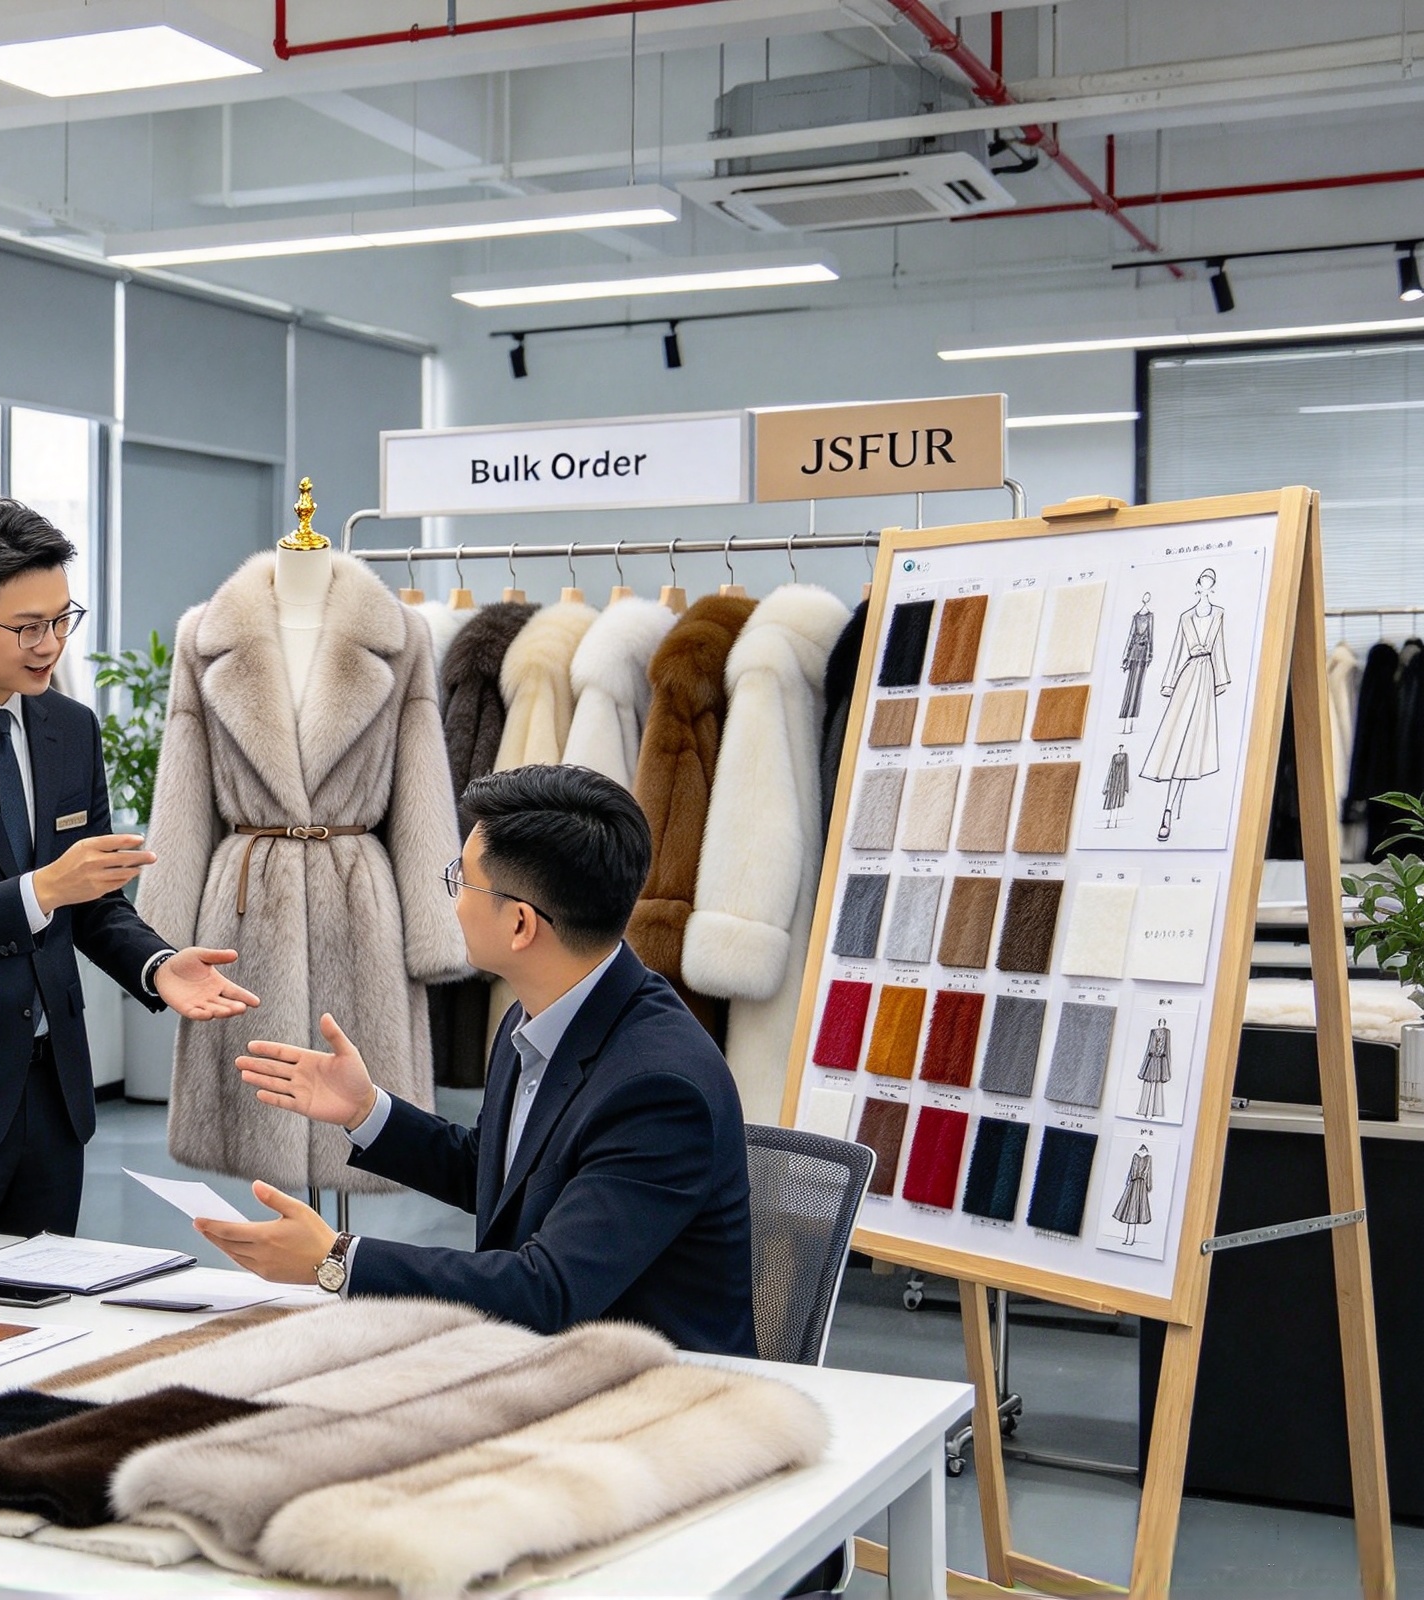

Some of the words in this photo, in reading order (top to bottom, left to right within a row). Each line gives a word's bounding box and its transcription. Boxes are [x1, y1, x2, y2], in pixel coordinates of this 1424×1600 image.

[471, 454, 541, 485] Bulk
[551, 449, 647, 481] Order
[800, 427, 957, 475] JSFUR
